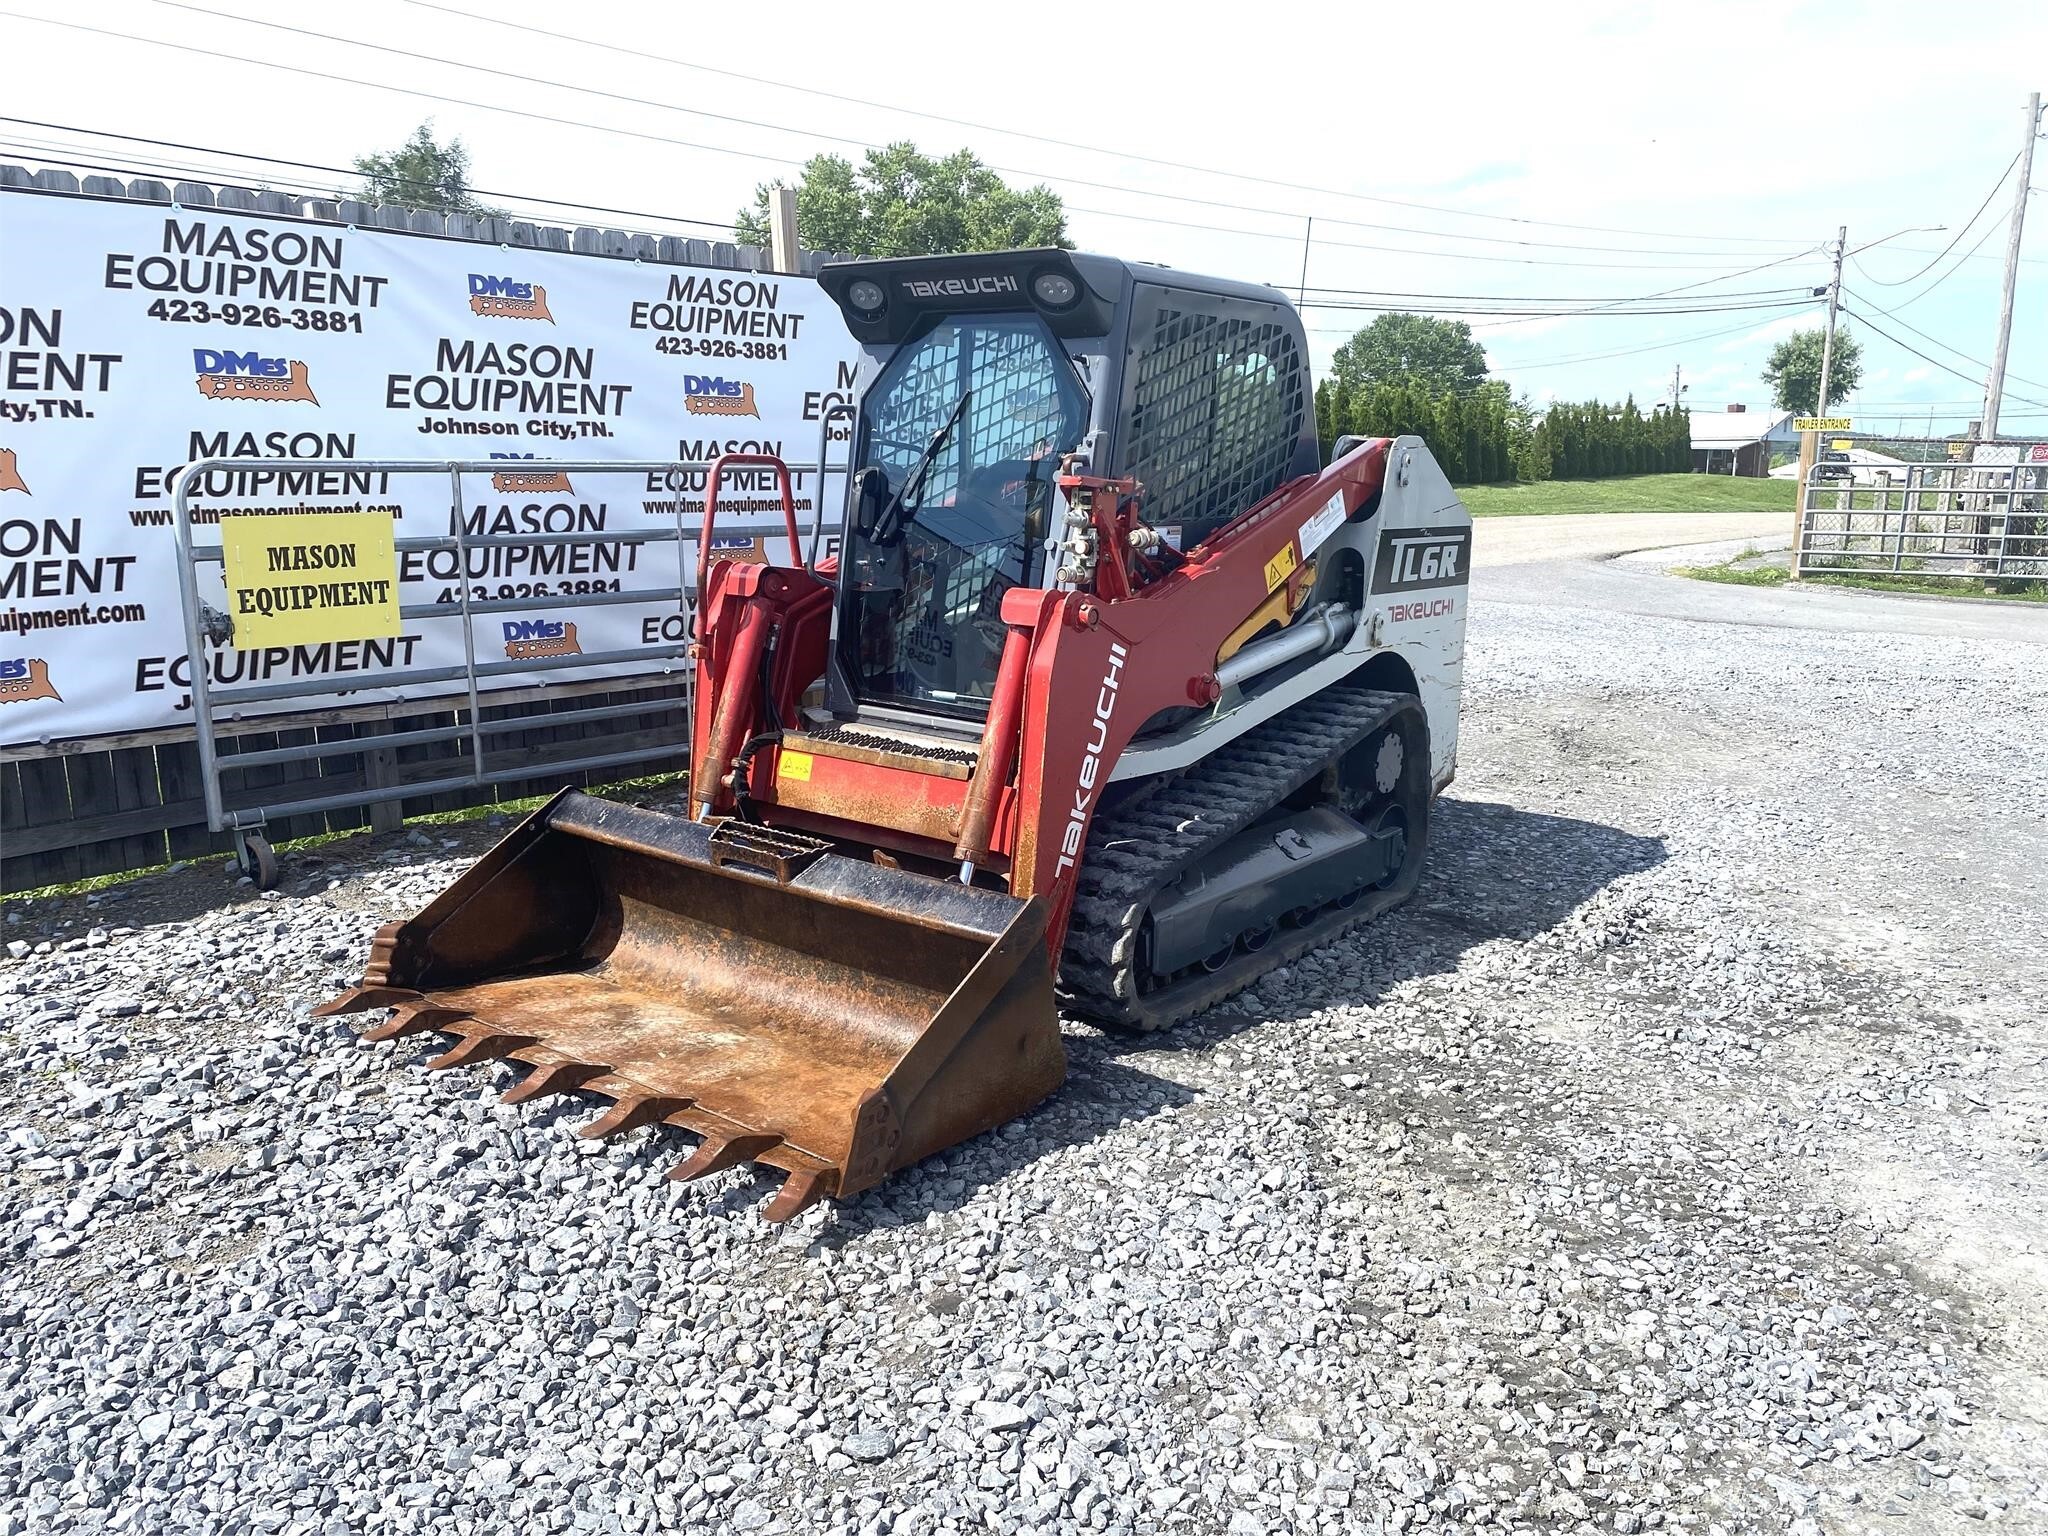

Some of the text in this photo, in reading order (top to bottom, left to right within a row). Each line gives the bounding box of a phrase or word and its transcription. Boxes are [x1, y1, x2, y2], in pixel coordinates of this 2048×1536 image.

[163, 218, 343, 269] MASON
[105, 253, 388, 308] EQUIPMENT
[666, 274, 779, 310] MASON
[147, 298, 363, 334] 423-926-3881
[630, 301, 805, 340] EQUIPMENT
[436, 338, 594, 380] MASON
[655, 336, 787, 361] 423-926-3881
[386, 374, 633, 416] EQUIPMENT
[418, 417, 519, 436] Johnson
[1795, 418, 1851, 430] TRAILER ENTRANCE
[188, 431, 355, 462] MASON
[680, 440, 782, 462] MASON
[449, 504, 607, 536] MASON
[267, 543, 357, 571] MASON
[400, 541, 645, 582] EQUIPMENT
[1390, 535, 1465, 583] TL6R
[237, 580, 390, 617] EQUIPMENT
